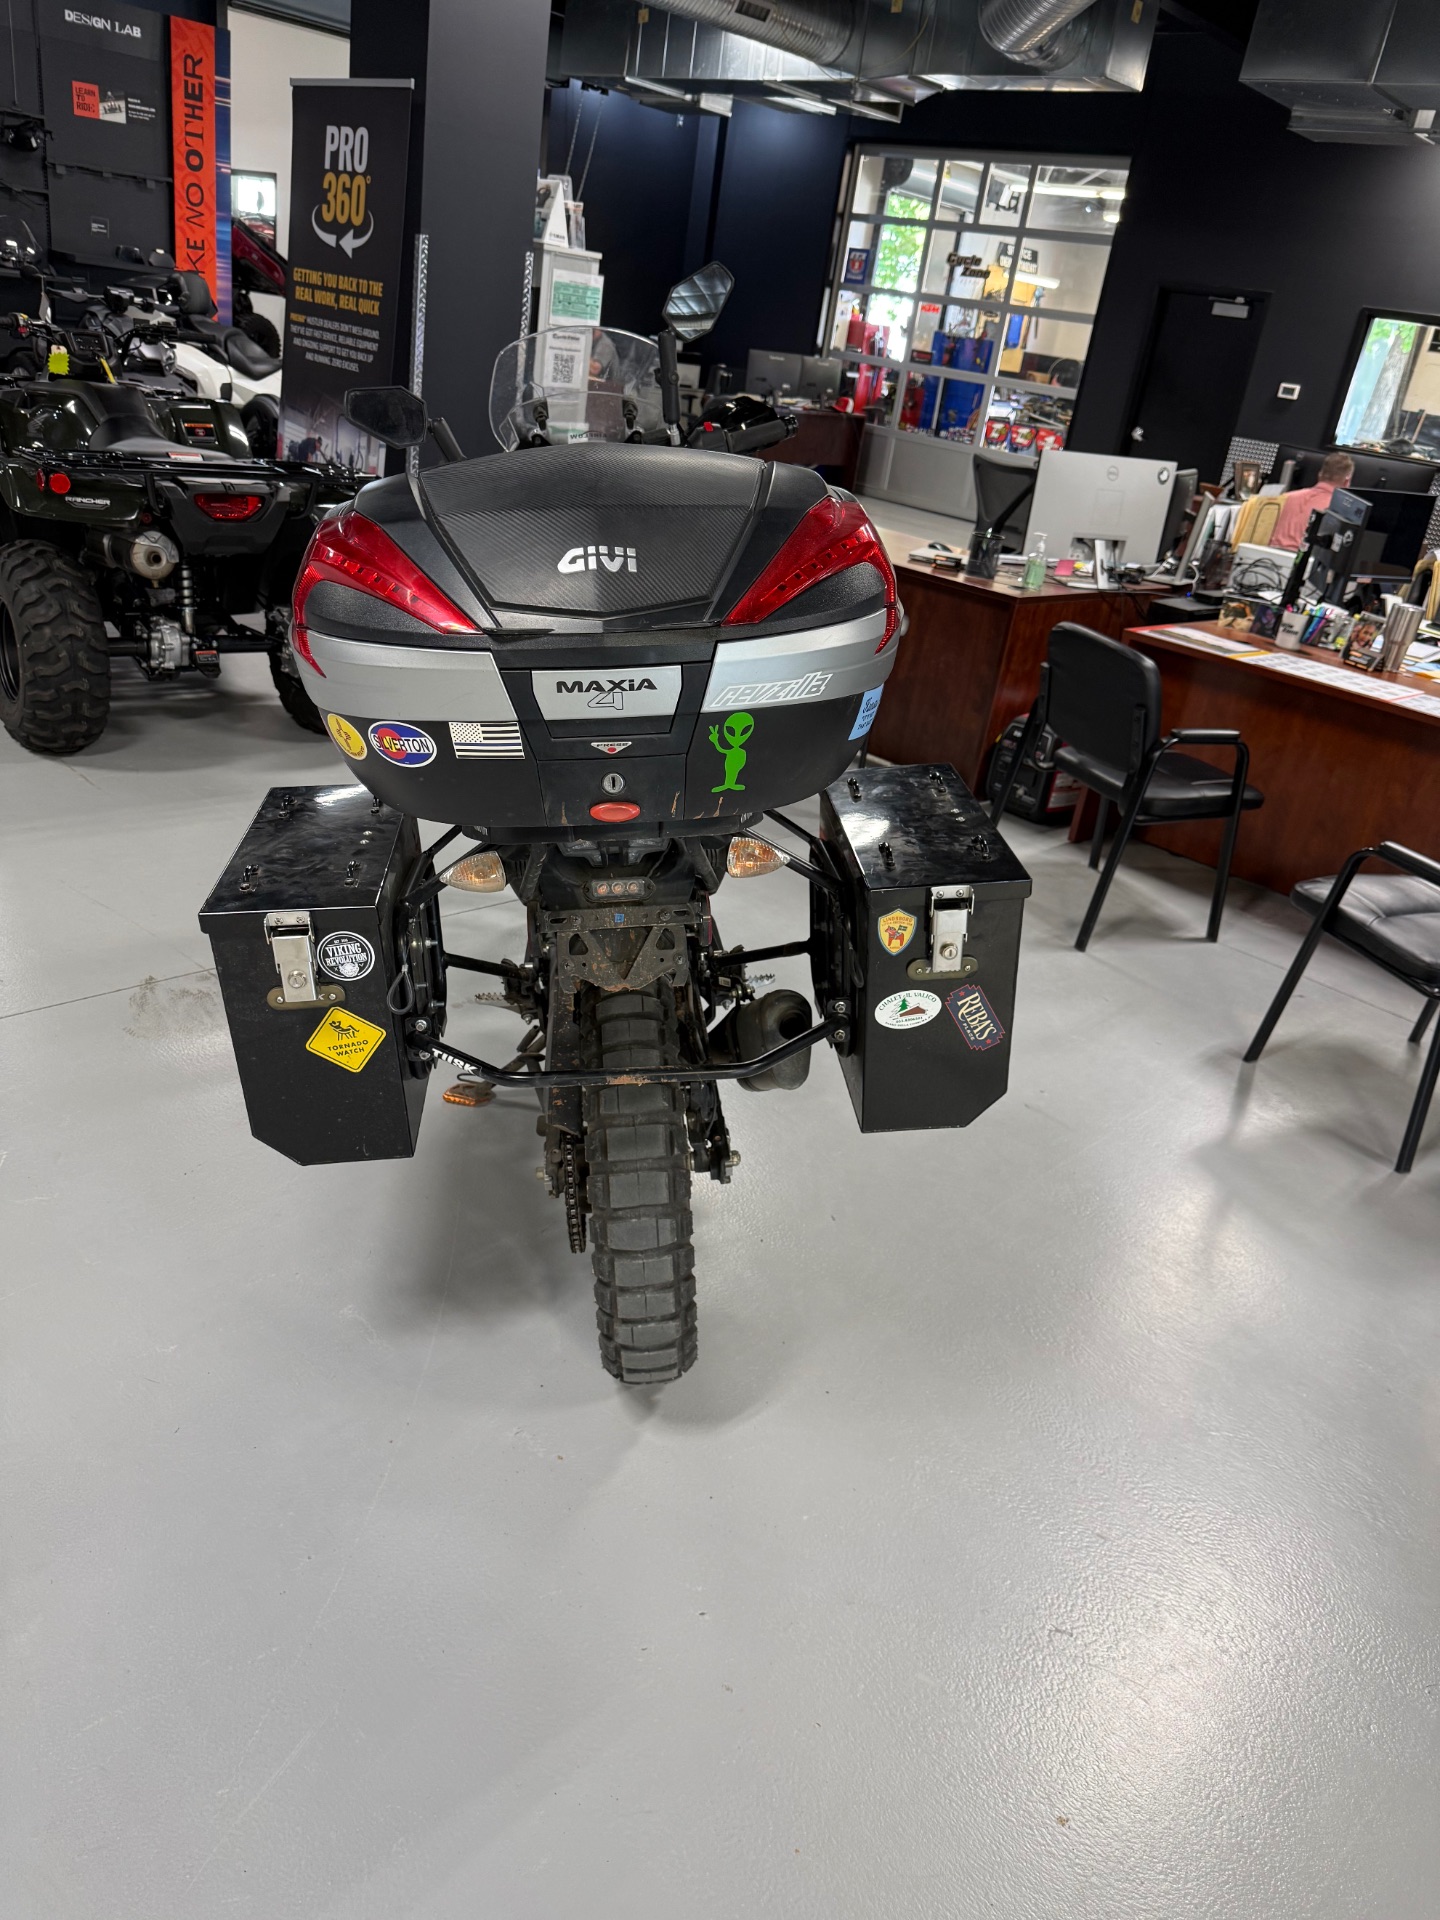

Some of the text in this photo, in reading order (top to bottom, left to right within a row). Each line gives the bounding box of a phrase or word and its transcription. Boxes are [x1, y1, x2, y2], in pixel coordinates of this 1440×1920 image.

[64, 9, 142, 38] DESIGN LAB
[75, 87, 96, 97] LEARN
[183, 54, 204, 172] OTHER
[324, 125, 369, 174] PRO
[186, 183, 206, 228] NO
[293, 267, 384, 297] GETTING YOU BACK TO THE
[295, 286, 380, 316] REAL WORK, REAL QUICK
[65, 496, 110, 506] RANCHER
[557, 546, 637, 574] GIVI
[710, 671, 833, 708] revzilla
[587, 691, 624, 710] 4
[372, 734, 432, 754] SILVERTON
[325, 942, 362, 958] VIKING
[325, 952, 368, 966] REVOLUTION
[879, 994, 902, 1010] CHALET
[914, 992, 936, 1002] VALICO
[957, 992, 996, 1040] REBA'S
[963, 1023, 975, 1040] PLACE
[328, 1040, 368, 1052] TORNADO
[336, 1047, 364, 1056] WATCH
